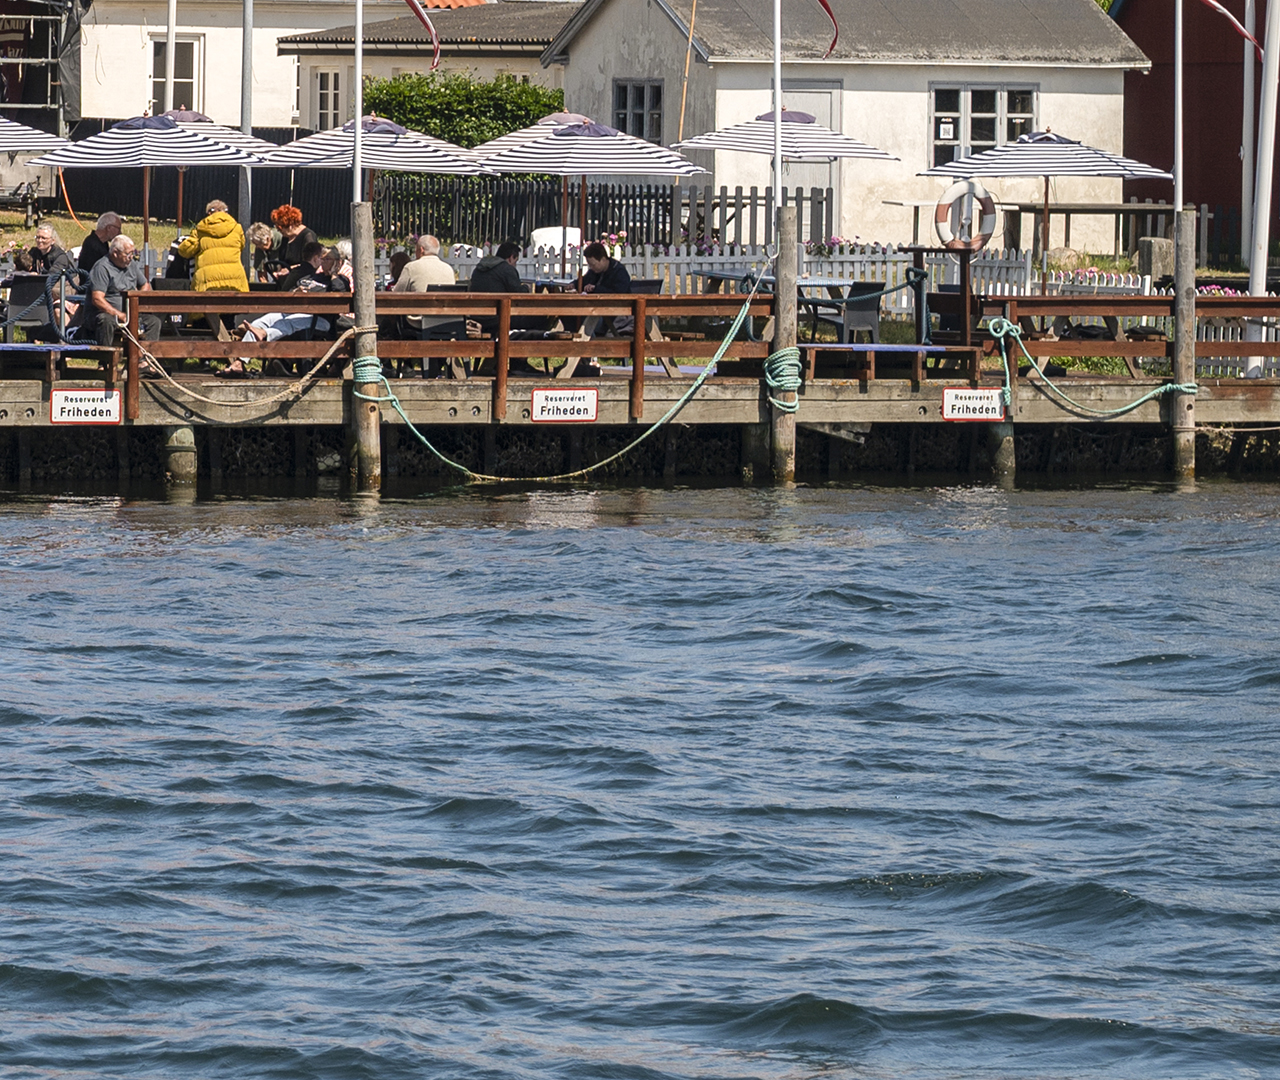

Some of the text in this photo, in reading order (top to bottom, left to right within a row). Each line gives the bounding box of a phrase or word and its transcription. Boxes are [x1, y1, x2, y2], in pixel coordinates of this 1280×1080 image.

[64, 395, 108, 403] Reserveret
[60, 407, 111, 417] Friheden
[540, 406, 589, 416] Friheden
[951, 404, 997, 414] Friheden
